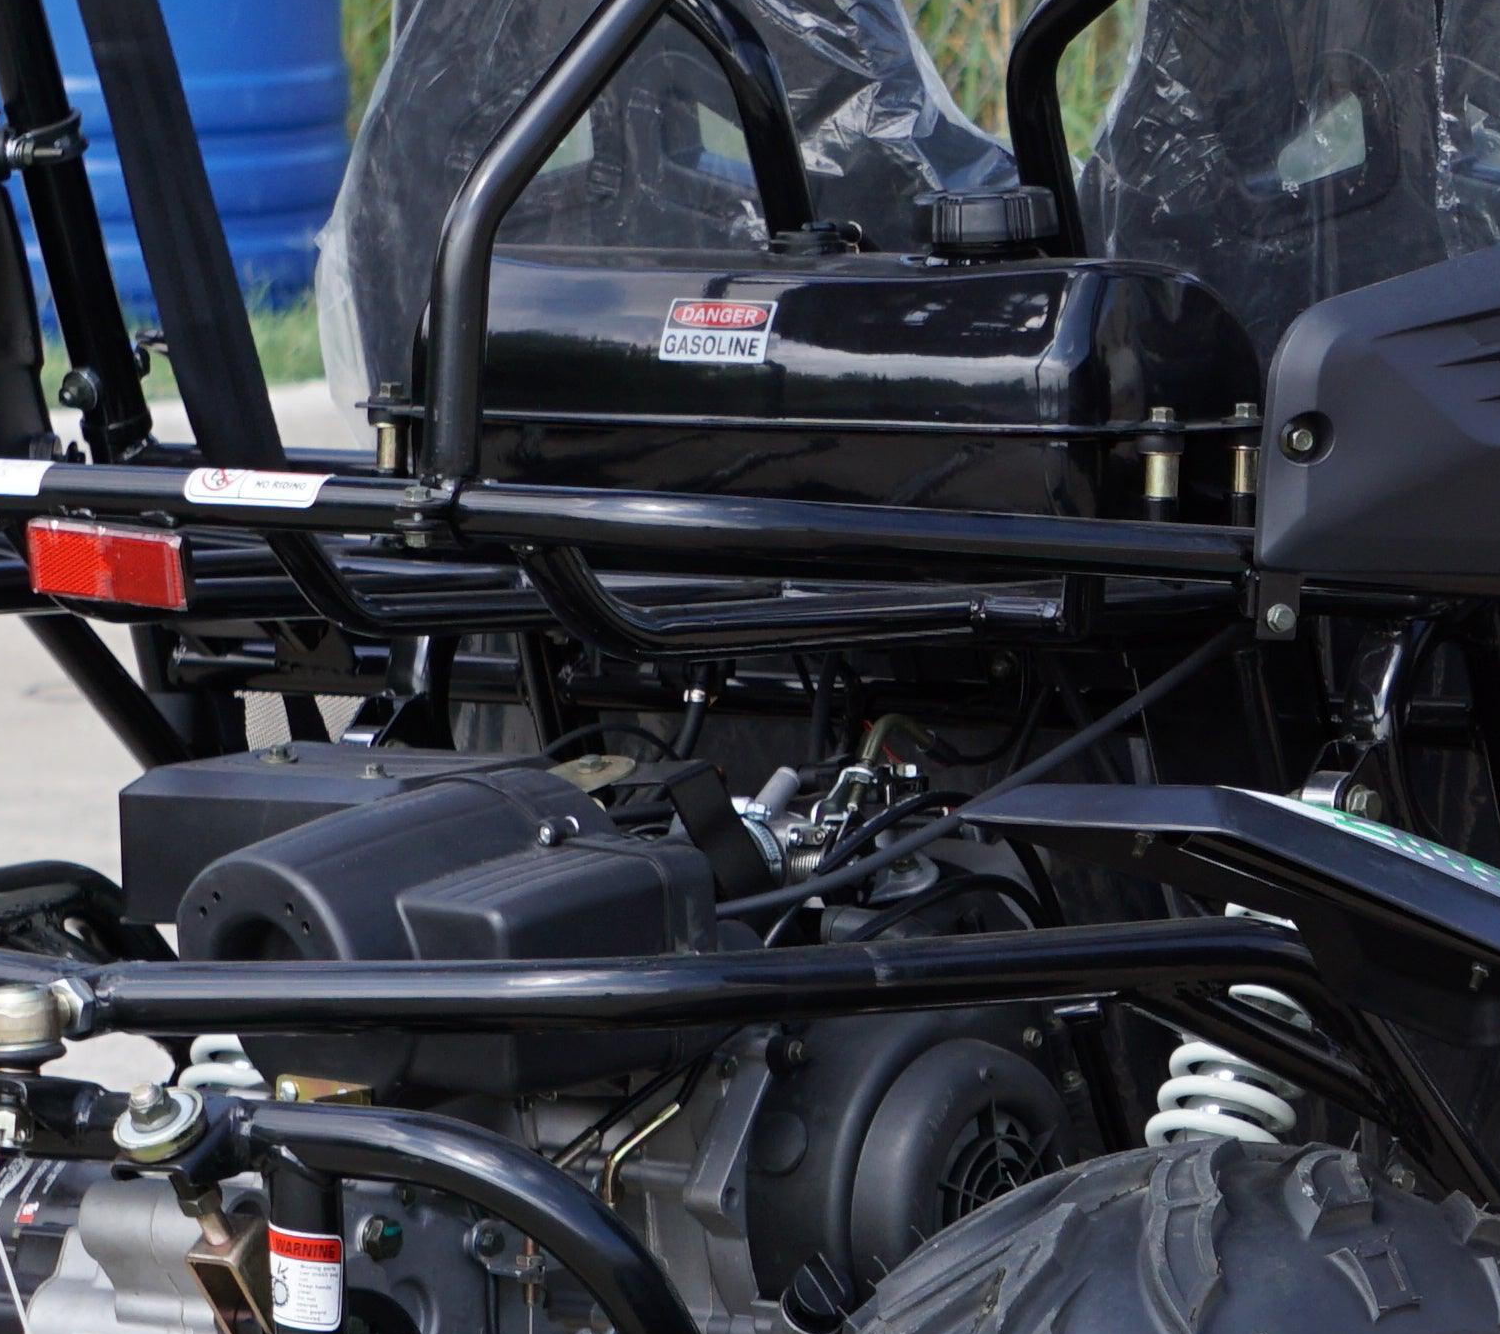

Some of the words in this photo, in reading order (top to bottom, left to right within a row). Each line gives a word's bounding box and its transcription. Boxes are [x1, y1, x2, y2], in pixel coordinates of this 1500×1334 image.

[681, 307, 758, 325] DANGER
[664, 334, 760, 357] GASOLINE
[256, 480, 269, 489] NO
[273, 481, 308, 491] RIDING
